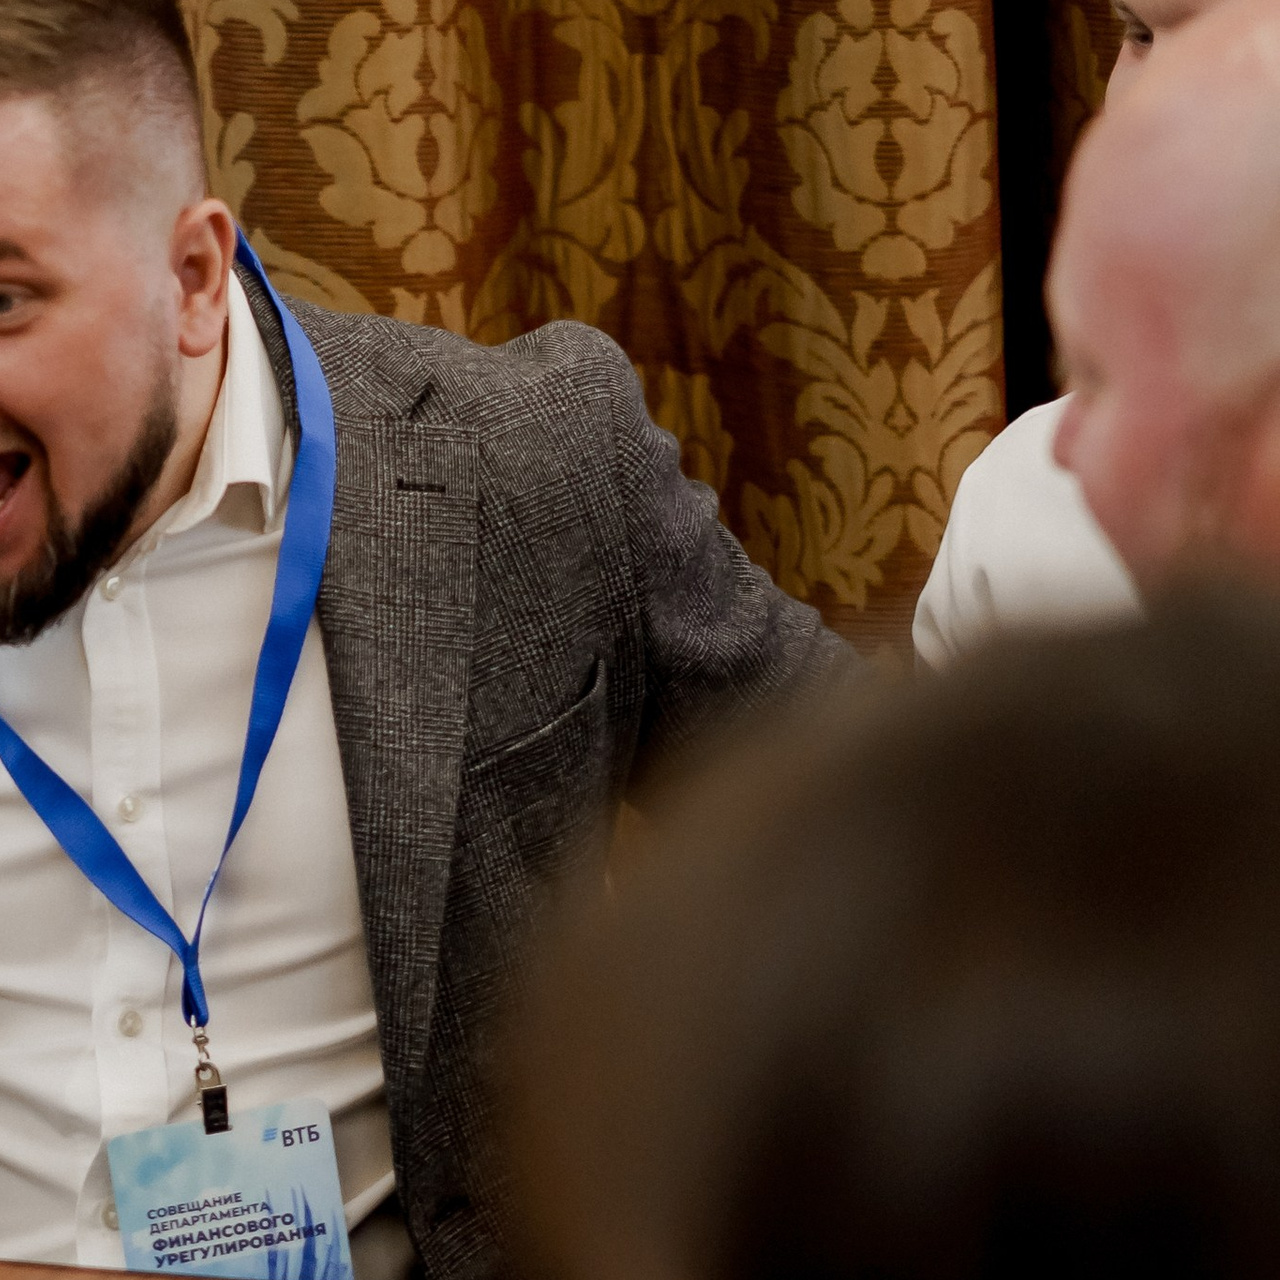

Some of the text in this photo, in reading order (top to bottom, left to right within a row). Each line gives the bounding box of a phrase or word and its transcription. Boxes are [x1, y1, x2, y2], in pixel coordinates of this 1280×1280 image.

[281, 1124, 320, 1147] ВТБ
[147, 1192, 243, 1219] СОВЕЩАНИЕ
[150, 1201, 273, 1235] ДЕПАРТАМЕНТА
[153, 1213, 295, 1251] ФИНАНСОВОГО
[154, 1222, 327, 1268] УРЕГУЛИРОВАНИЯ
